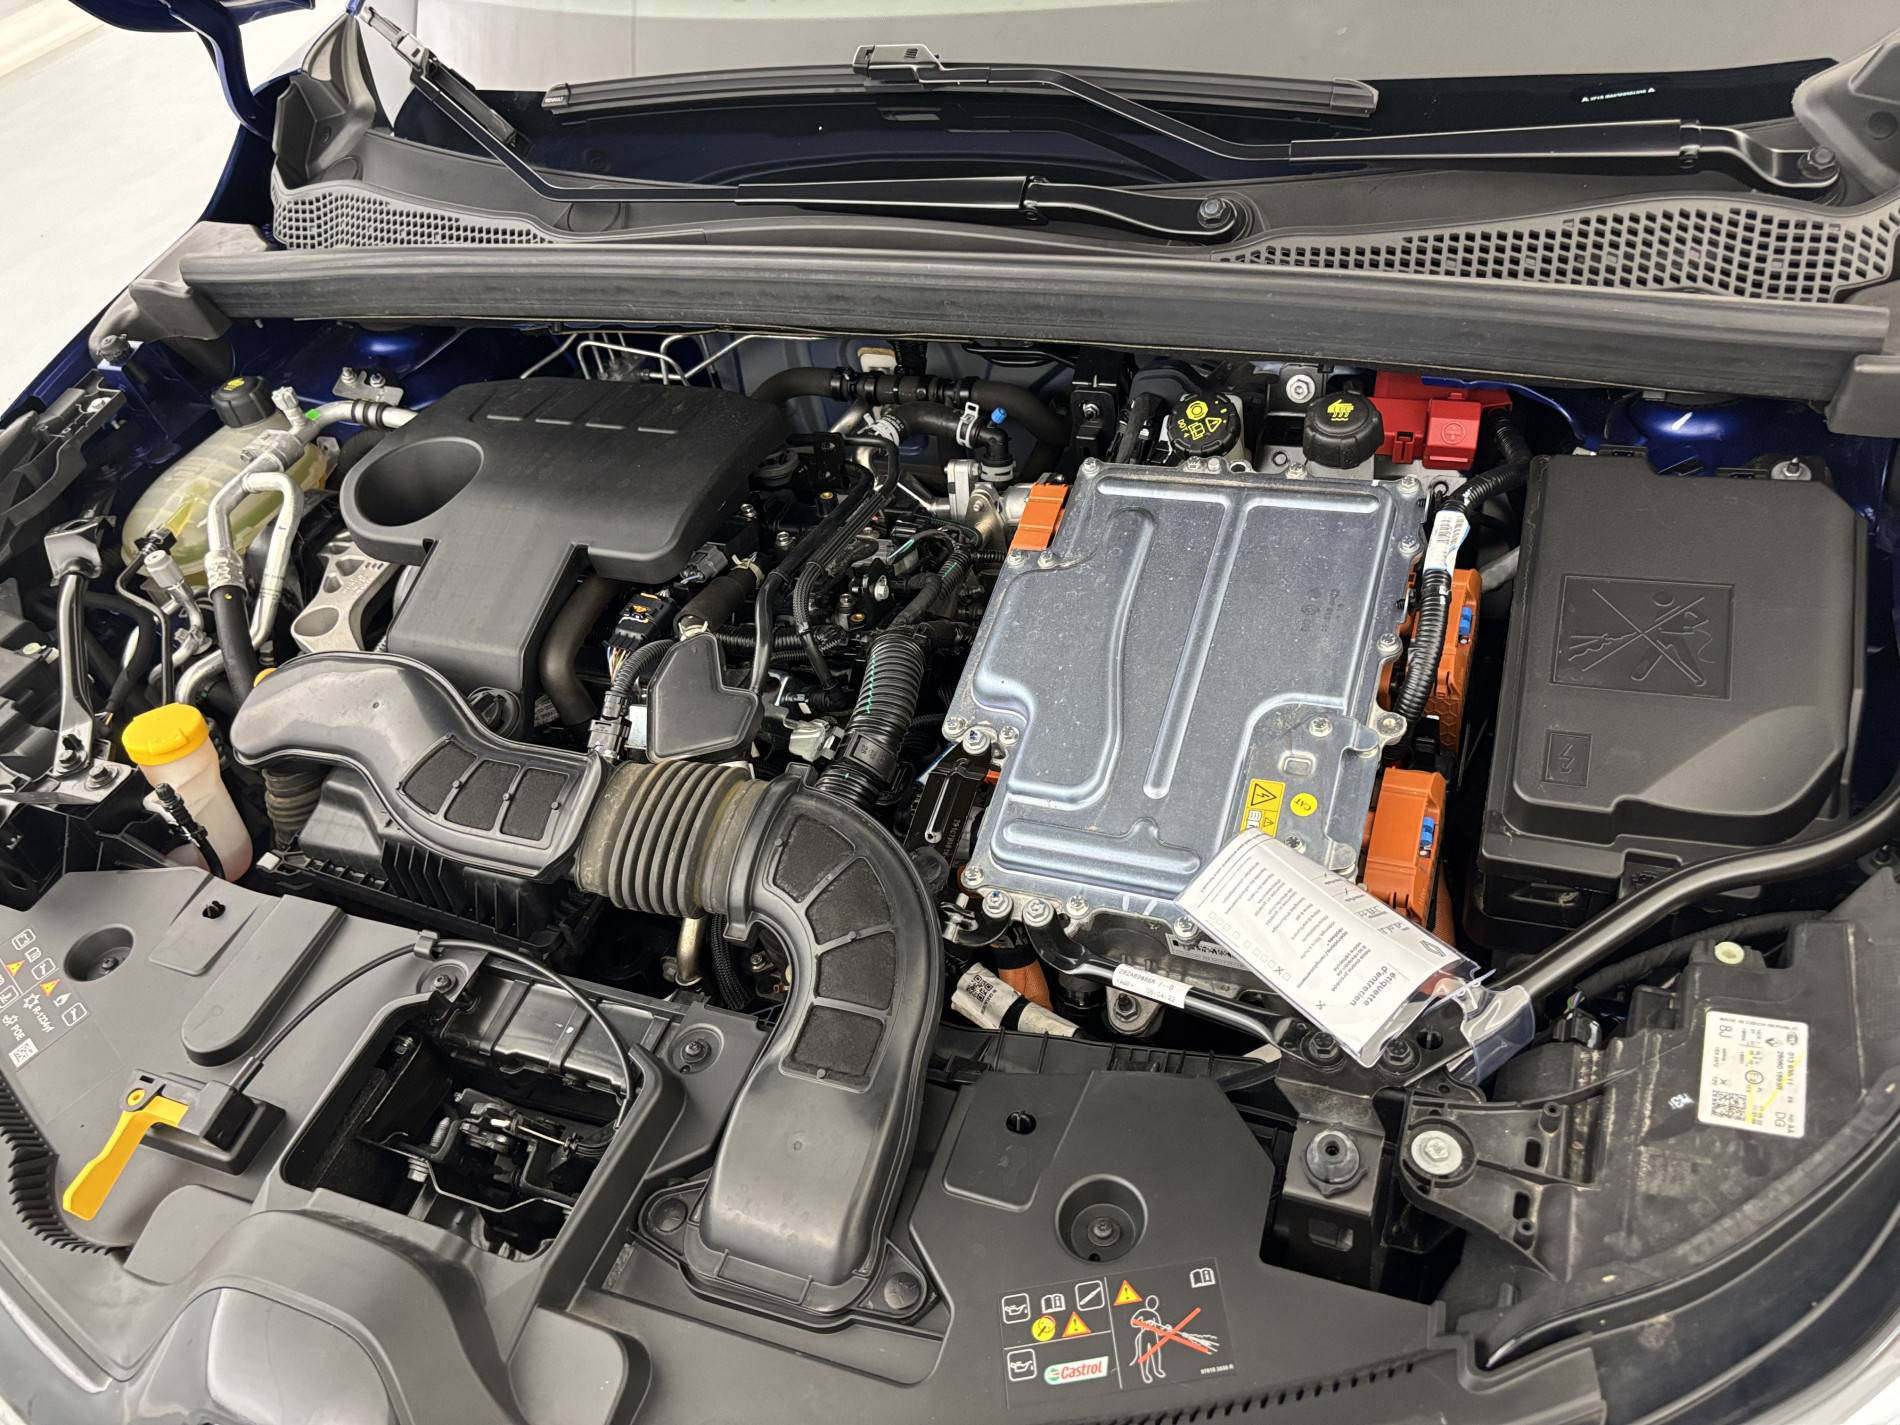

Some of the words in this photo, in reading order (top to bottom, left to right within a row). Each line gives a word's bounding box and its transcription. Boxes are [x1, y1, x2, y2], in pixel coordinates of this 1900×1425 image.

[1362, 971, 1396, 1006] étiquette
[10, 1024, 25, 1040] POE
[1059, 1360, 1103, 1379] Castrol
